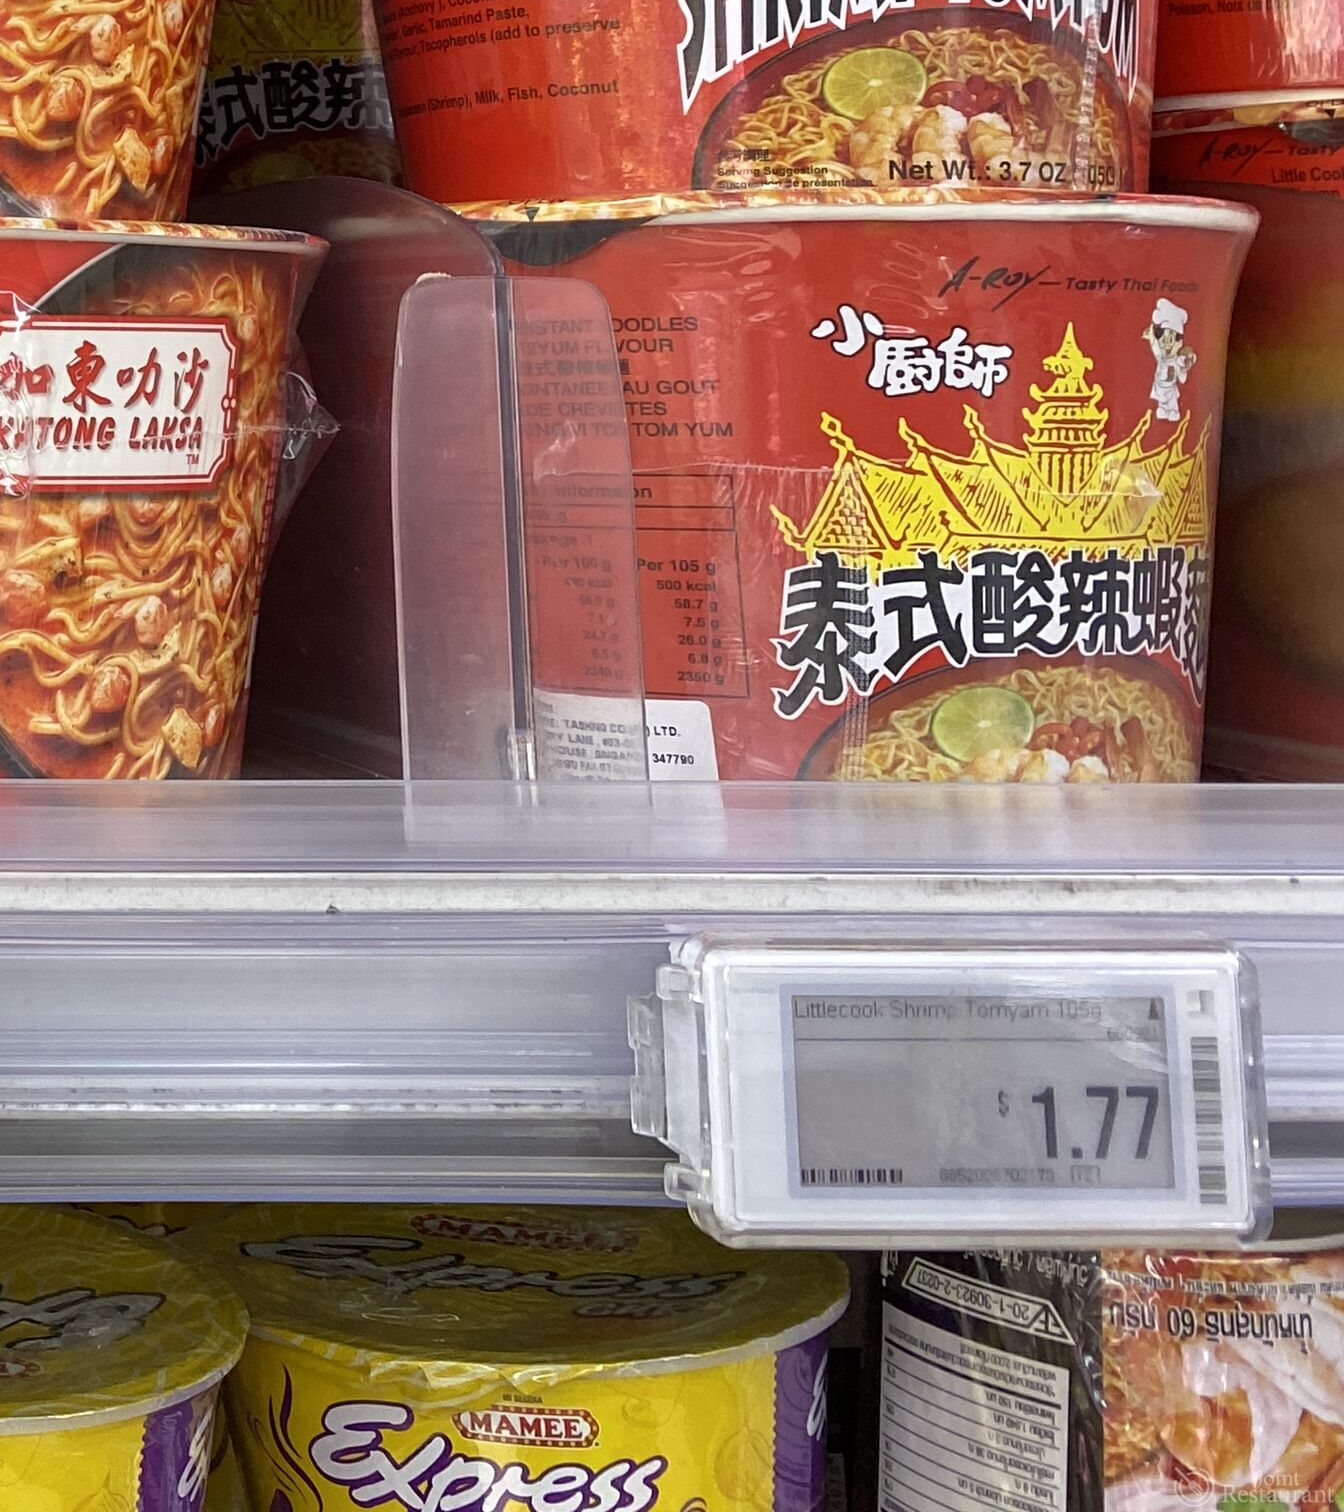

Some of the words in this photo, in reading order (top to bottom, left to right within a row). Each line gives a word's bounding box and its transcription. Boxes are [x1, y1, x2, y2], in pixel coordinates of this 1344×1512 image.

[547, 79, 620, 99] Coconut
[889, 160, 933, 181] Net
[999, 161, 1031, 182] 3.7
[1039, 162, 1067, 183] OZ
[812, 304, 1013, 396] 小廚師
[128, 414, 204, 450] LAKSA
[632, 423, 678, 437] TOM
[685, 423, 733, 437] YUM
[669, 560, 700, 573] 105
[652, 754, 694, 765] 347790
[794, 1001, 883, 1019] Littlecook
[999, 1090, 1010, 1117] $
[1032, 1086, 1160, 1159] 1.77
[1167, 1310, 1196, 1336] 60
[468, 1414, 582, 1440] MAMEE
[313, 1402, 666, 1512] Express
